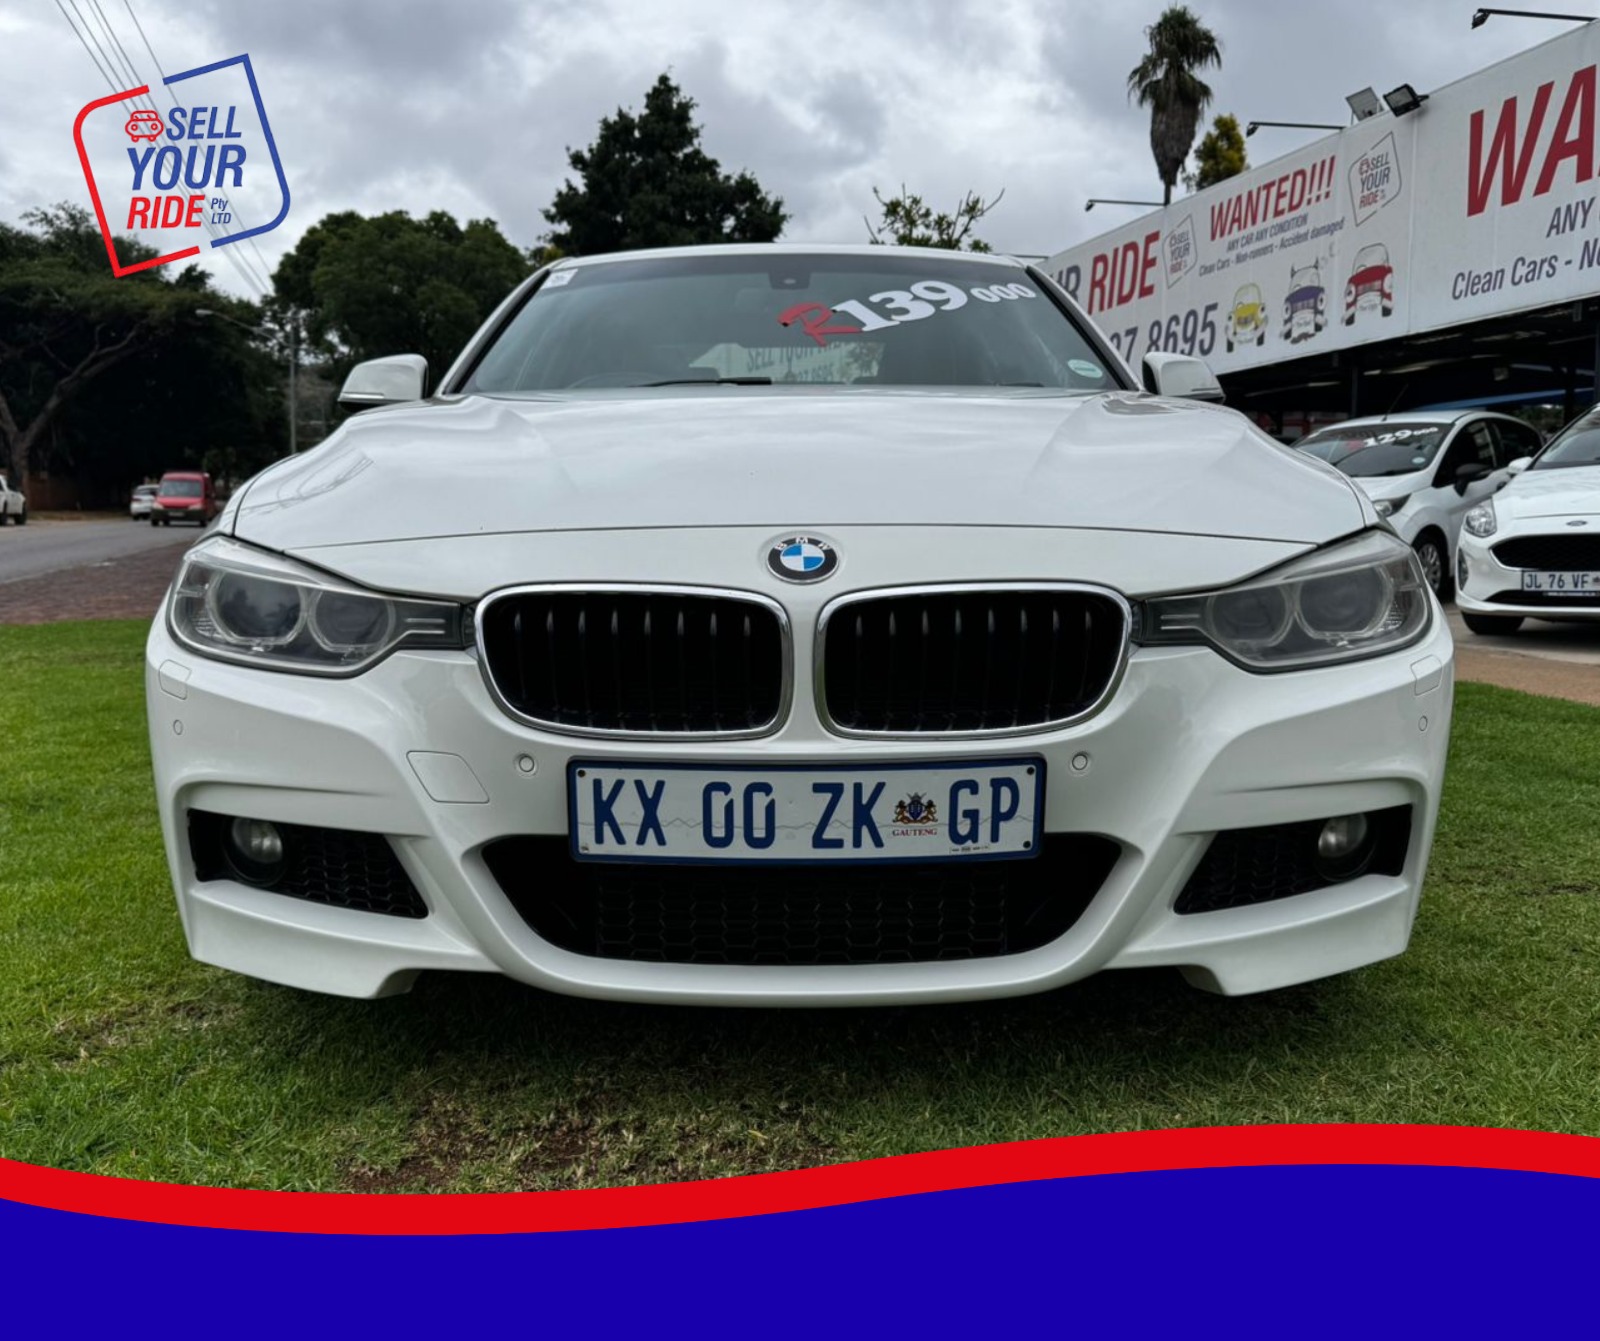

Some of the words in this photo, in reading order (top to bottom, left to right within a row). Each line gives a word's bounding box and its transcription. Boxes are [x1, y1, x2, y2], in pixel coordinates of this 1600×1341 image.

[1467, 64, 1600, 217] WA
[1360, 166, 1391, 194] YOUR
[1370, 152, 1390, 171] SELL
[1210, 155, 1335, 242] WANTED!!!
[1546, 197, 1596, 238] ANY
[970, 283, 1036, 302] 000
[1088, 230, 1161, 316] RIDE
[1451, 267, 1505, 300] Clean
[1511, 254, 1559, 286] Cars
[1147, 302, 1219, 357] 8695
[774, 536, 832, 551] BMW
[1525, 573, 1542, 589] JL
[1548, 573, 1565, 589] 76
[1571, 573, 1590, 589] VF
[592, 778, 667, 846] KX
[811, 781, 886, 849] ZK
[948, 776, 1020, 846] GP
[892, 827, 938, 837] GAUTENG
